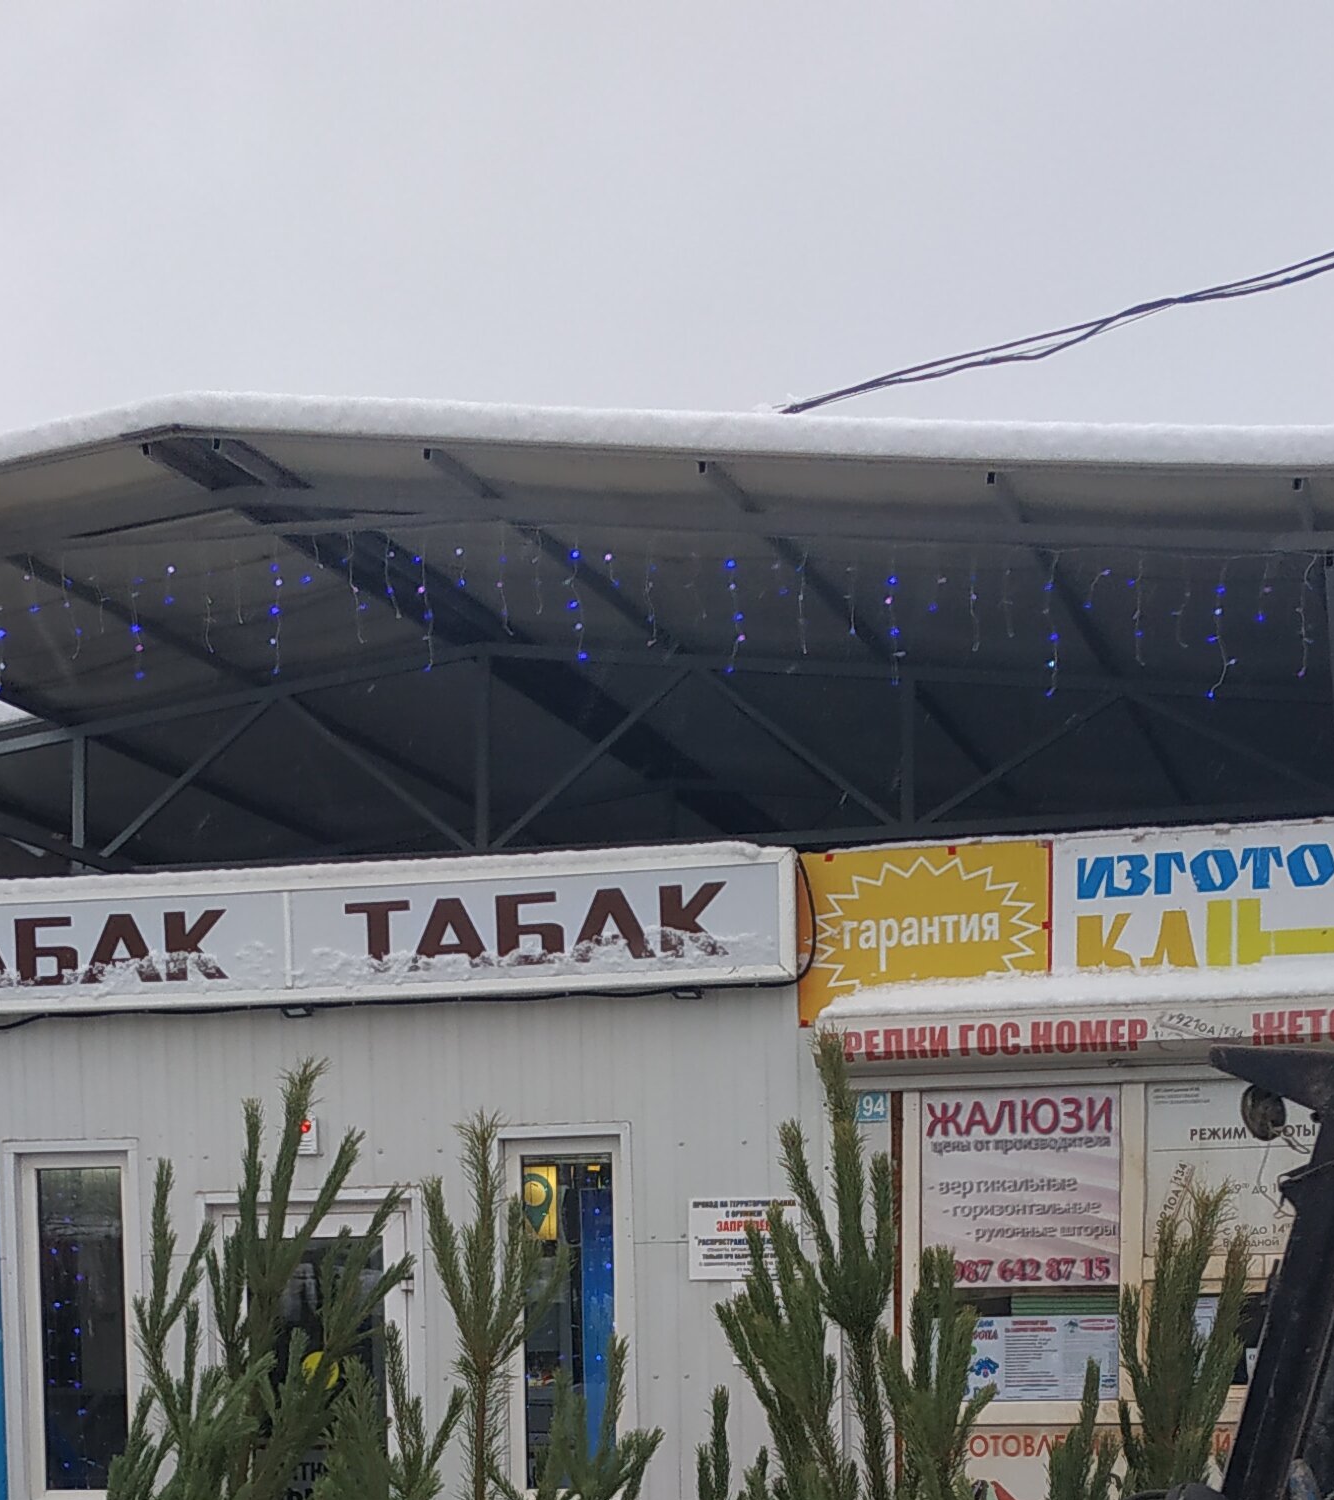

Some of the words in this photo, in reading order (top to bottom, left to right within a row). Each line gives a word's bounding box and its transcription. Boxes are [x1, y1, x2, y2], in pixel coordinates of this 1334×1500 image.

[344, 880, 729, 973] ТАБАК
[841, 910, 1002, 973] гарантия
[841, 1024, 951, 1063] РЕЛКИ
[959, 1017, 1149, 1058] ГОС.НОМЕР
[925, 1095, 1114, 1138] ЖАЛЮЗИ
[1189, 1126, 1247, 1142] РЕЖИМ
[997, 1258, 1042, 1282] 642
[1045, 1256, 1077, 1281] 87
[1080, 1256, 1111, 1281] 15
